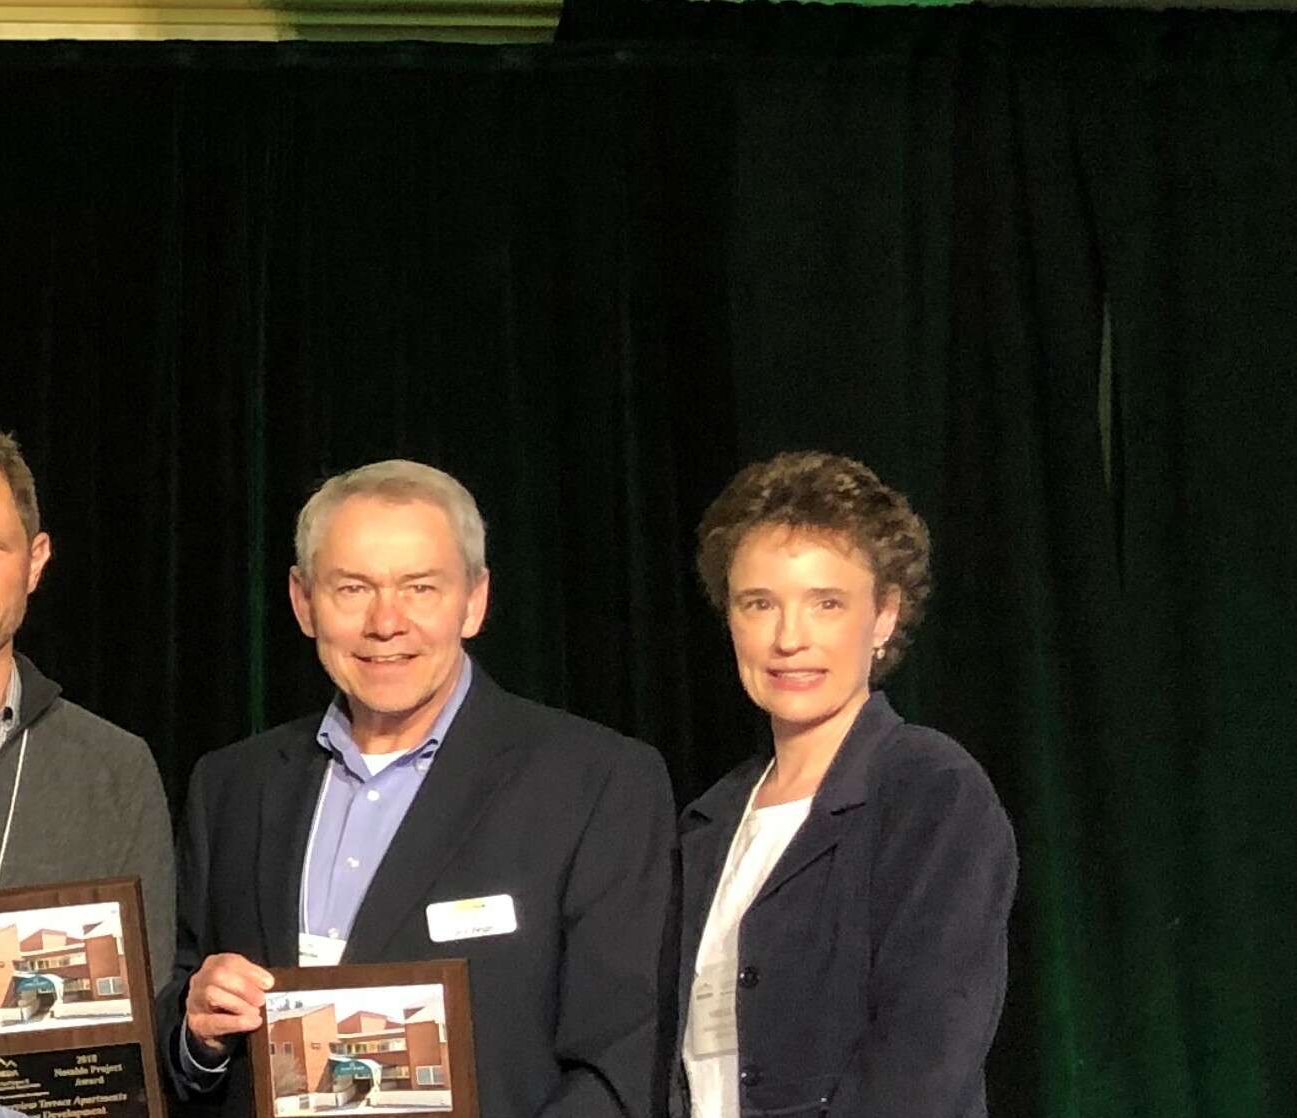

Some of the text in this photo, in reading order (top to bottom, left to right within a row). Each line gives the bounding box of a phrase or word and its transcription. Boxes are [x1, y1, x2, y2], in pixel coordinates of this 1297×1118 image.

[54, 1063, 123, 1077] Notable Project
[75, 1076, 104, 1087] Award
[39, 1098, 72, 1110] Terrace
[73, 1093, 128, 1107] Apartments
